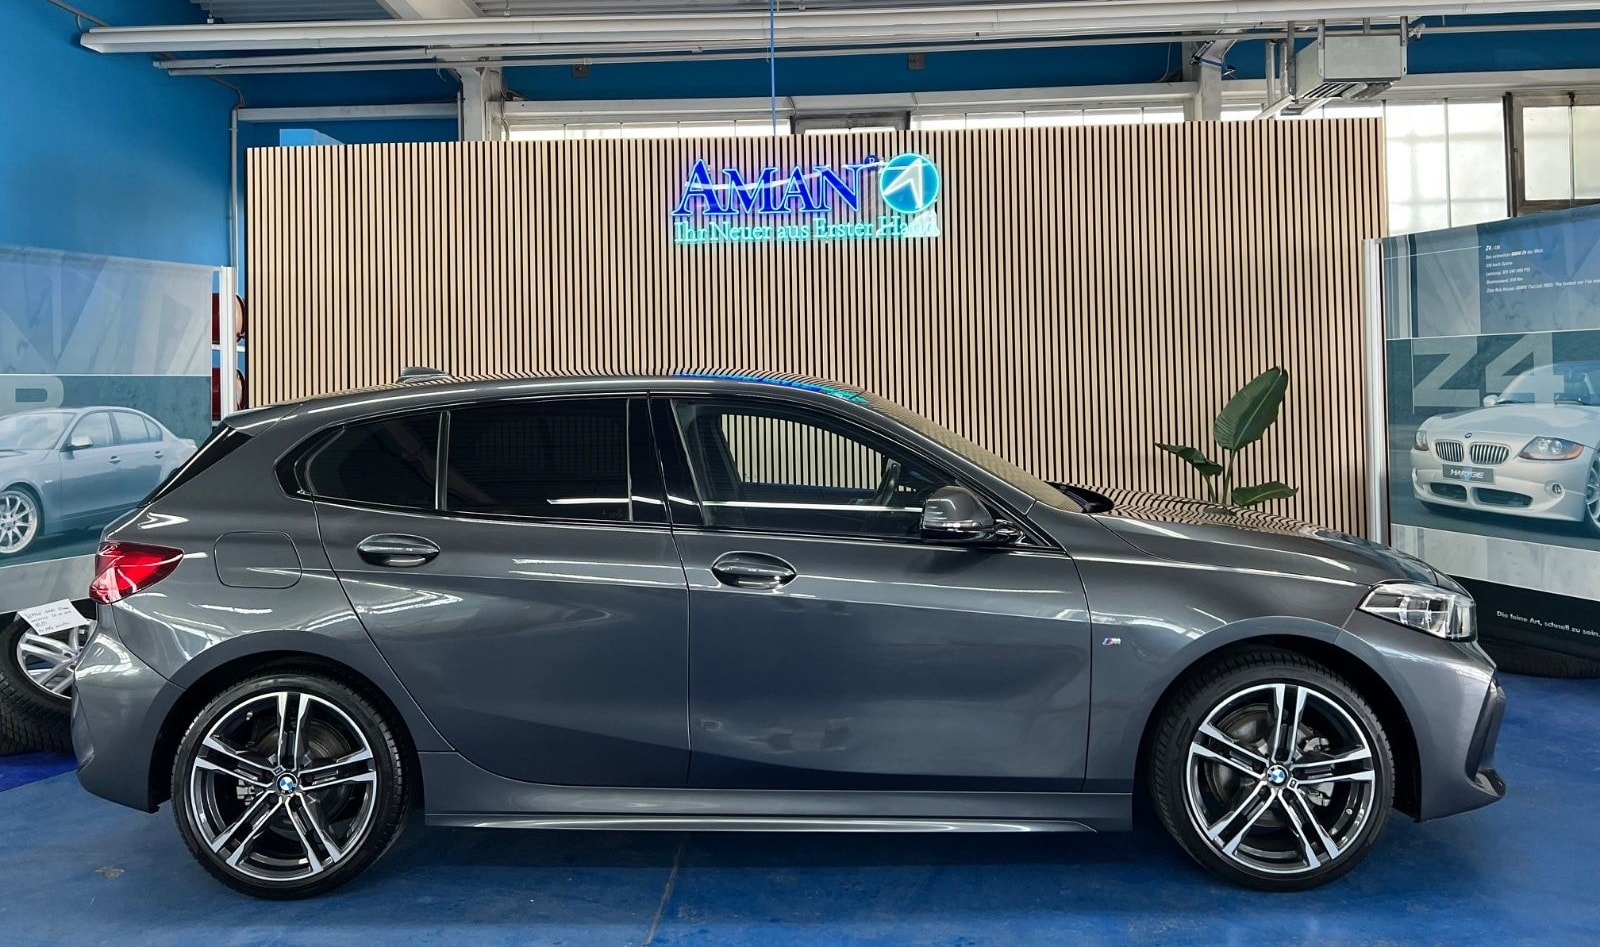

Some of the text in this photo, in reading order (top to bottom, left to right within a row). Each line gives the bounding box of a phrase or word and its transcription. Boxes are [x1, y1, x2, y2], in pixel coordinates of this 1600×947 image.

[671, 157, 864, 216] AMAN
[674, 221, 708, 243] Ihr
[709, 220, 771, 242] Neuer
[776, 223, 810, 240] aus
[812, 218, 873, 239] Erster
[1413, 332, 1565, 408] Z4
[1496, 610, 1509, 619] Die
[1510, 613, 1528, 623] feine
[1544, 621, 1570, 631] schnell
